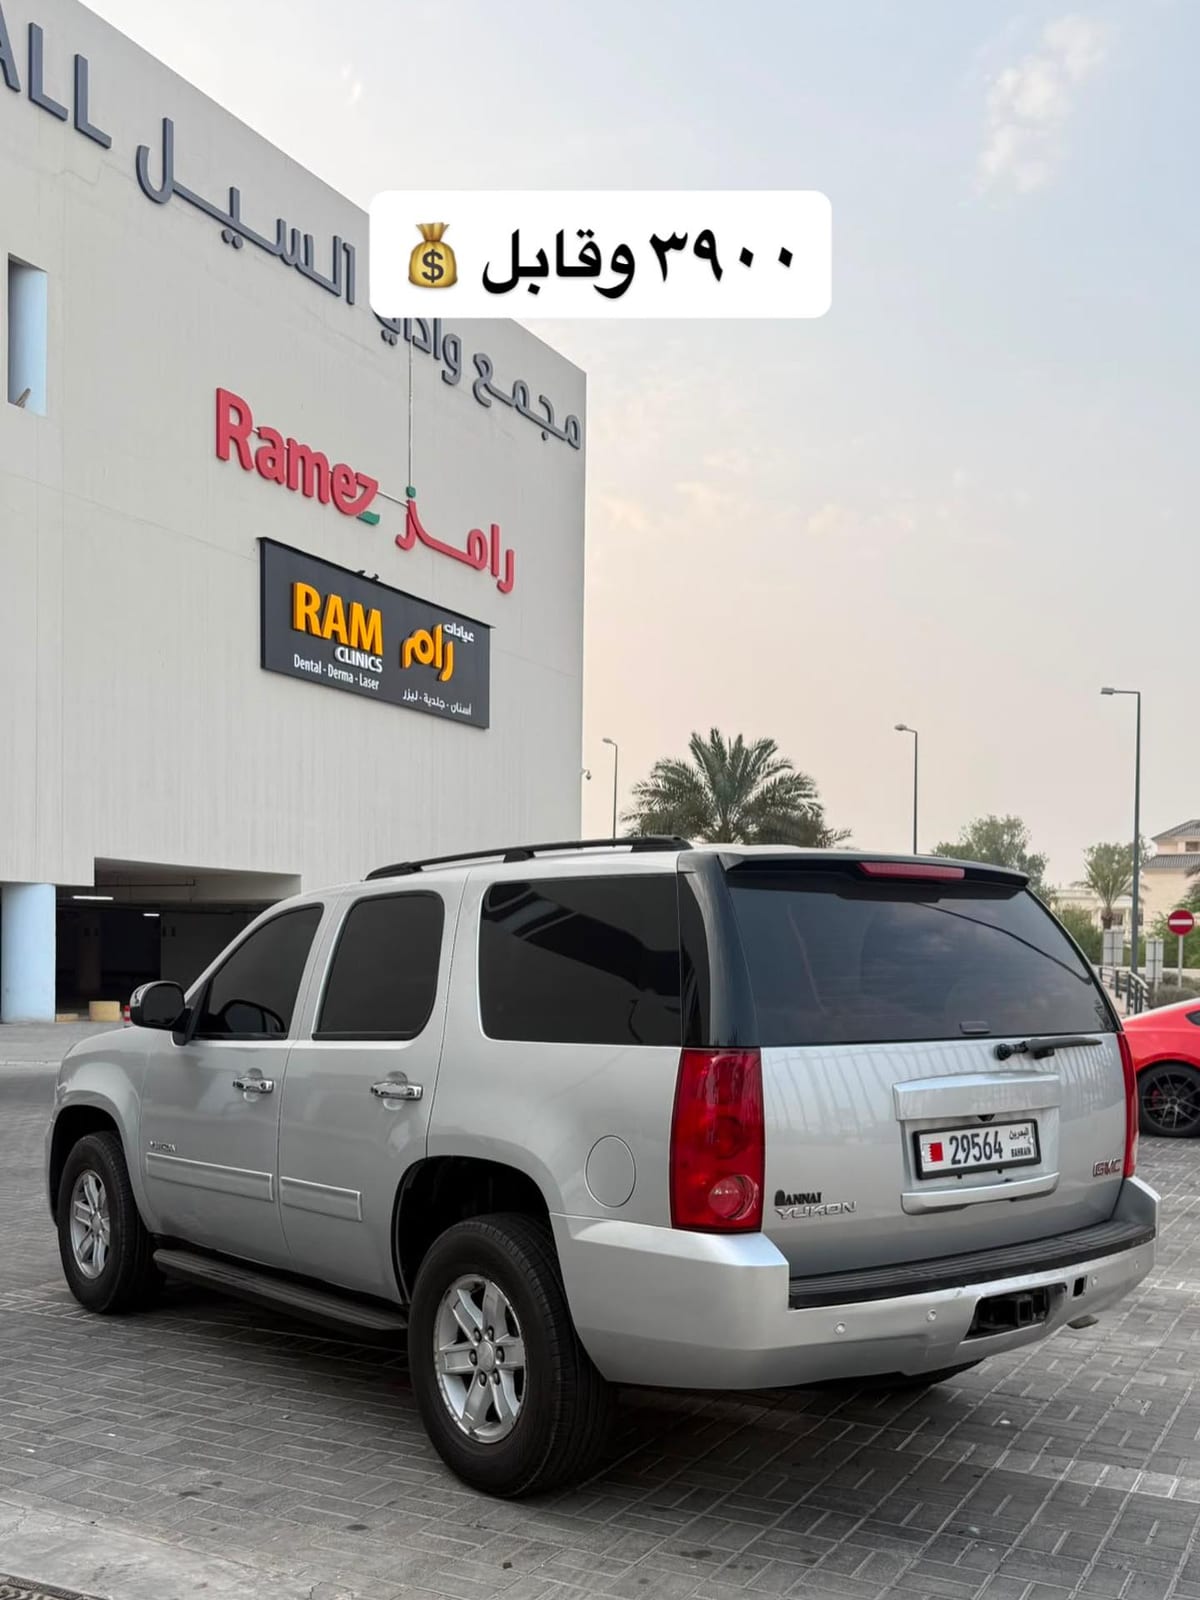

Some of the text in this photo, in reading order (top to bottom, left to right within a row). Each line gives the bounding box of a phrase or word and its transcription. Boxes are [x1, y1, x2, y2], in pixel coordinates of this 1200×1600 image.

[135, 117, 355, 305] السيل
[472, 352, 581, 450] مجمع
[215, 387, 380, 526] Ramez
[395, 485, 515, 594] رامز
[293, 581, 384, 657] RAM
[293, 653, 322, 675] Dental
[328, 663, 354, 684] Derma
[359, 673, 380, 691] Laser
[334, 646, 384, 674] CLINICS
[401, 623, 455, 682] رام
[948, 1130, 1004, 1166] 29564
[1010, 1146, 1032, 1158] BAHRAIN
[1093, 1158, 1122, 1177] GMC
[774, 1200, 857, 1220] YUKON
